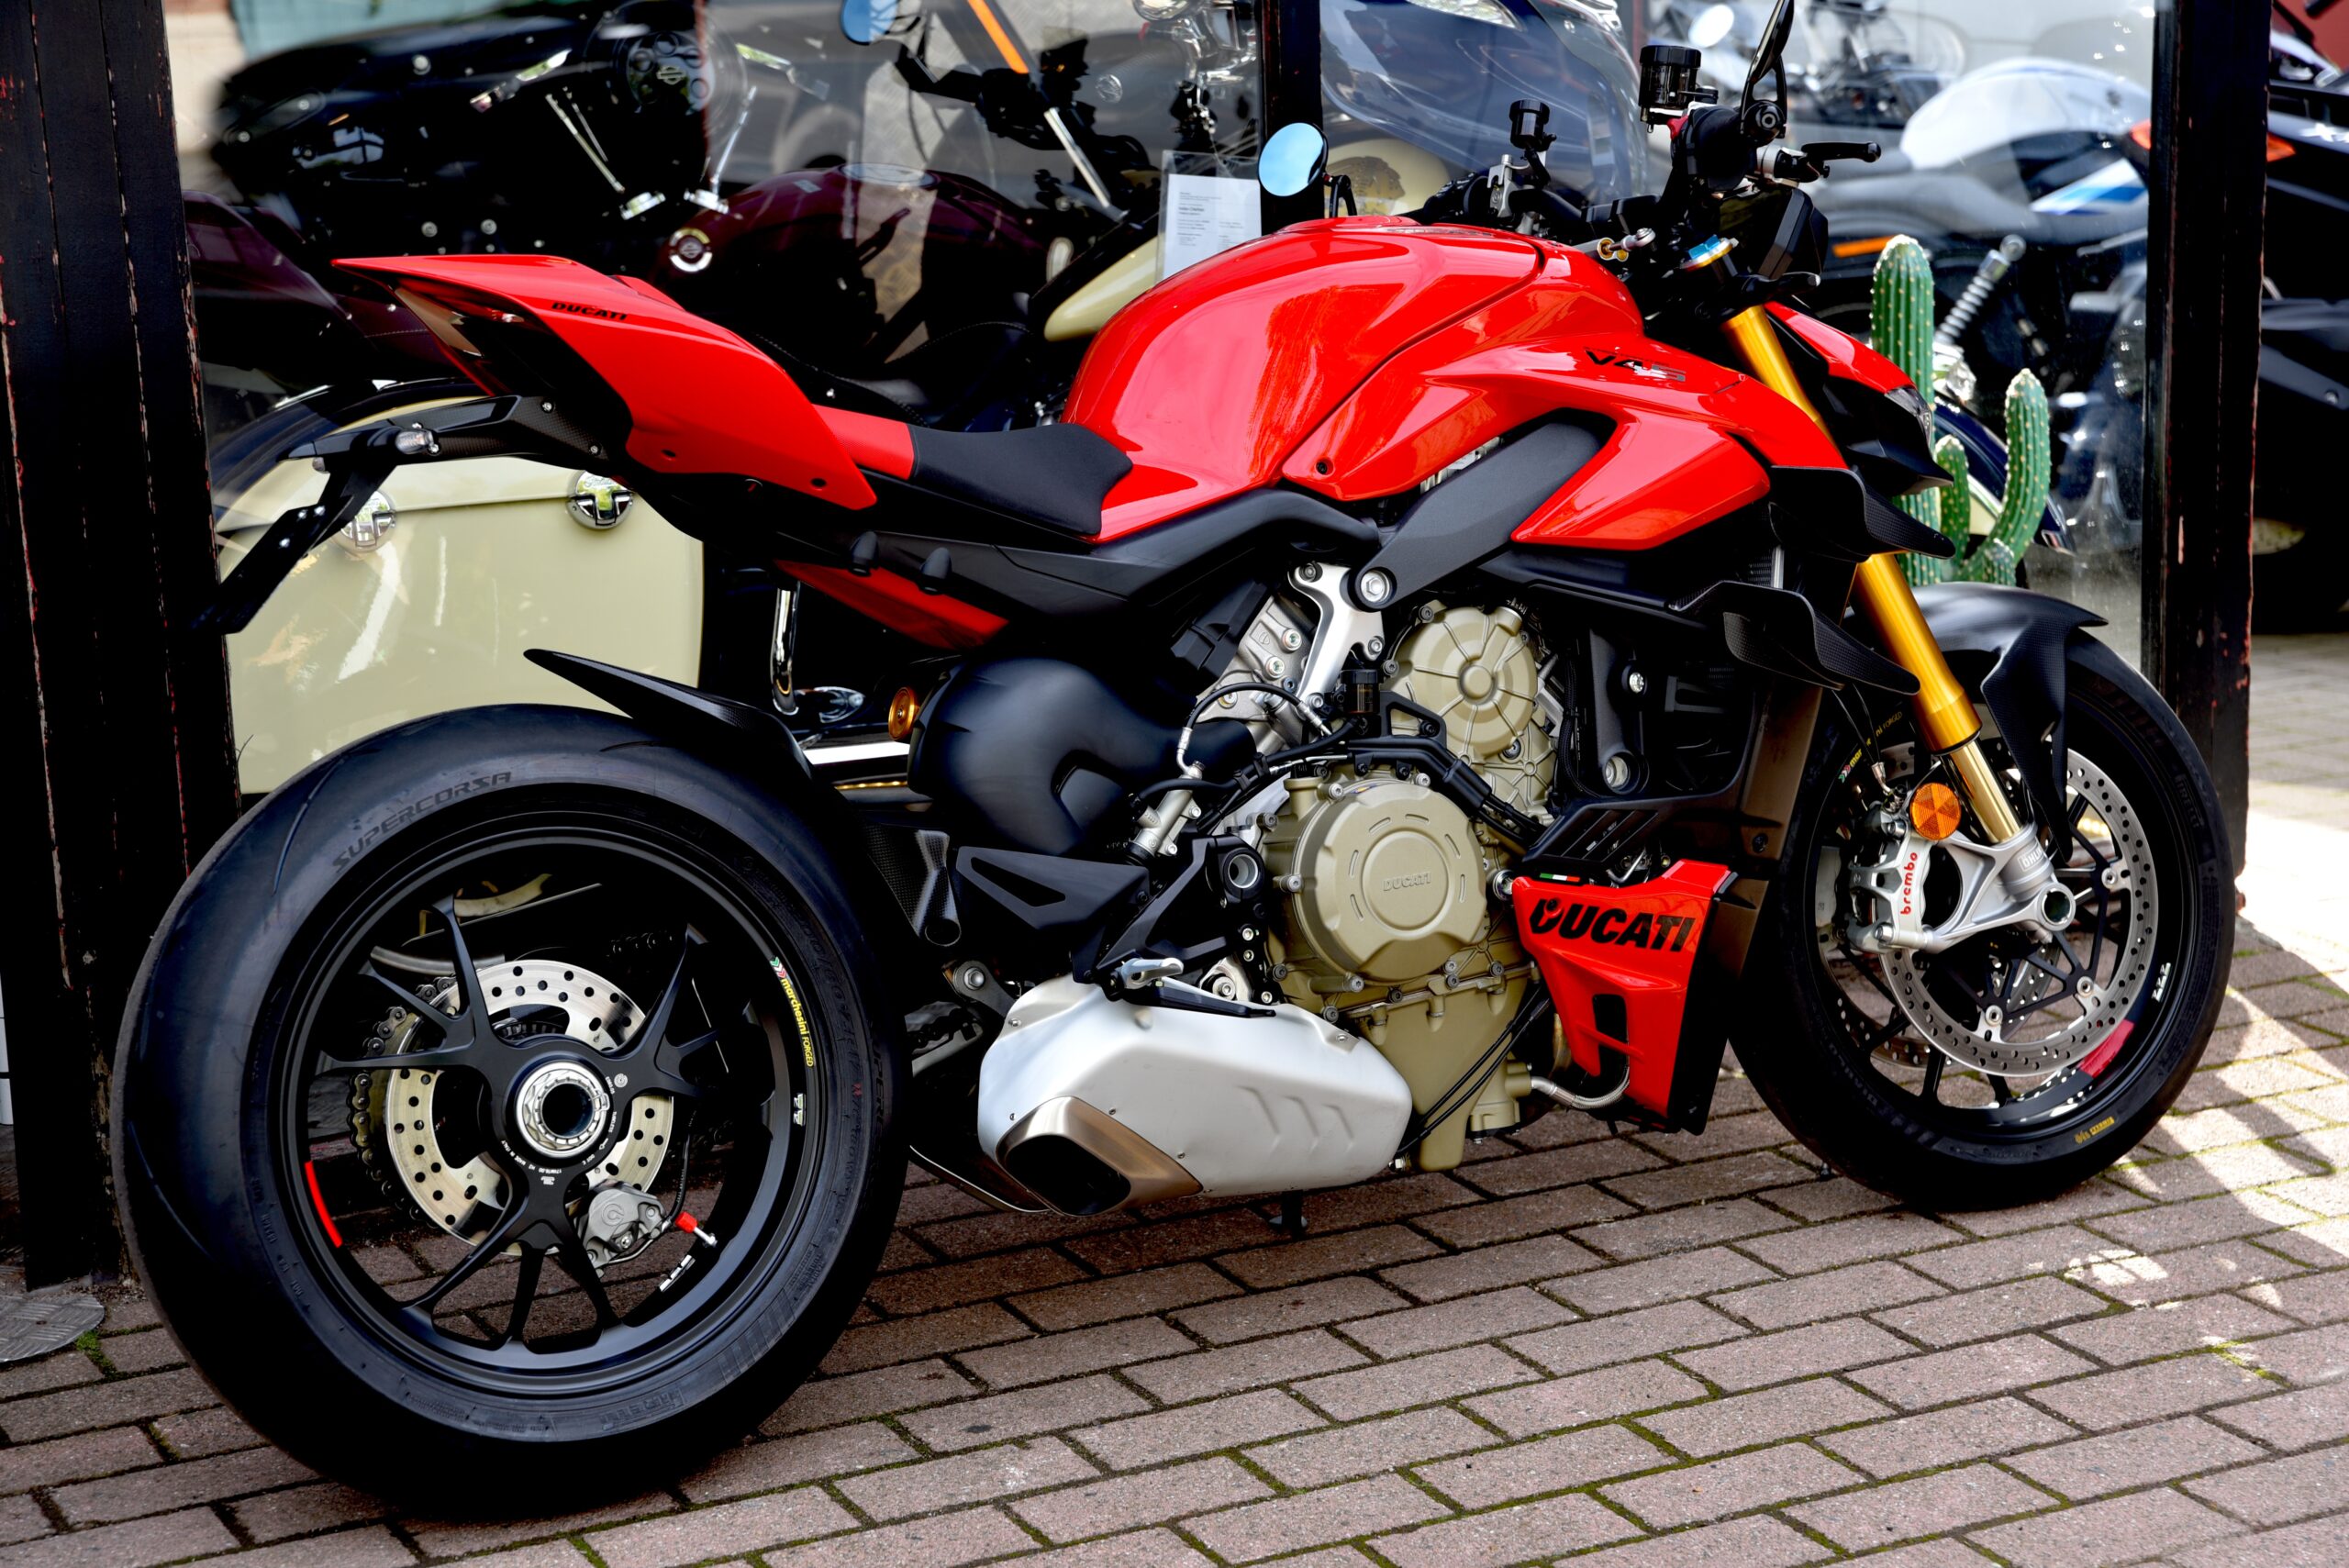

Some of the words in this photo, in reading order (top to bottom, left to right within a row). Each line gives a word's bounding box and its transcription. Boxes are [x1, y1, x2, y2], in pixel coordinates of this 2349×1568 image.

[551, 302, 628, 320] DUCATI
[331, 772, 511, 873] SUPERCORSA
[1383, 872, 1432, 892] DUCATI
[1900, 852, 1918, 915] brembo
[1530, 898, 1696, 952] DUCATI
[781, 978, 809, 1036] marchesini
[802, 1036, 814, 1068] FORGED
